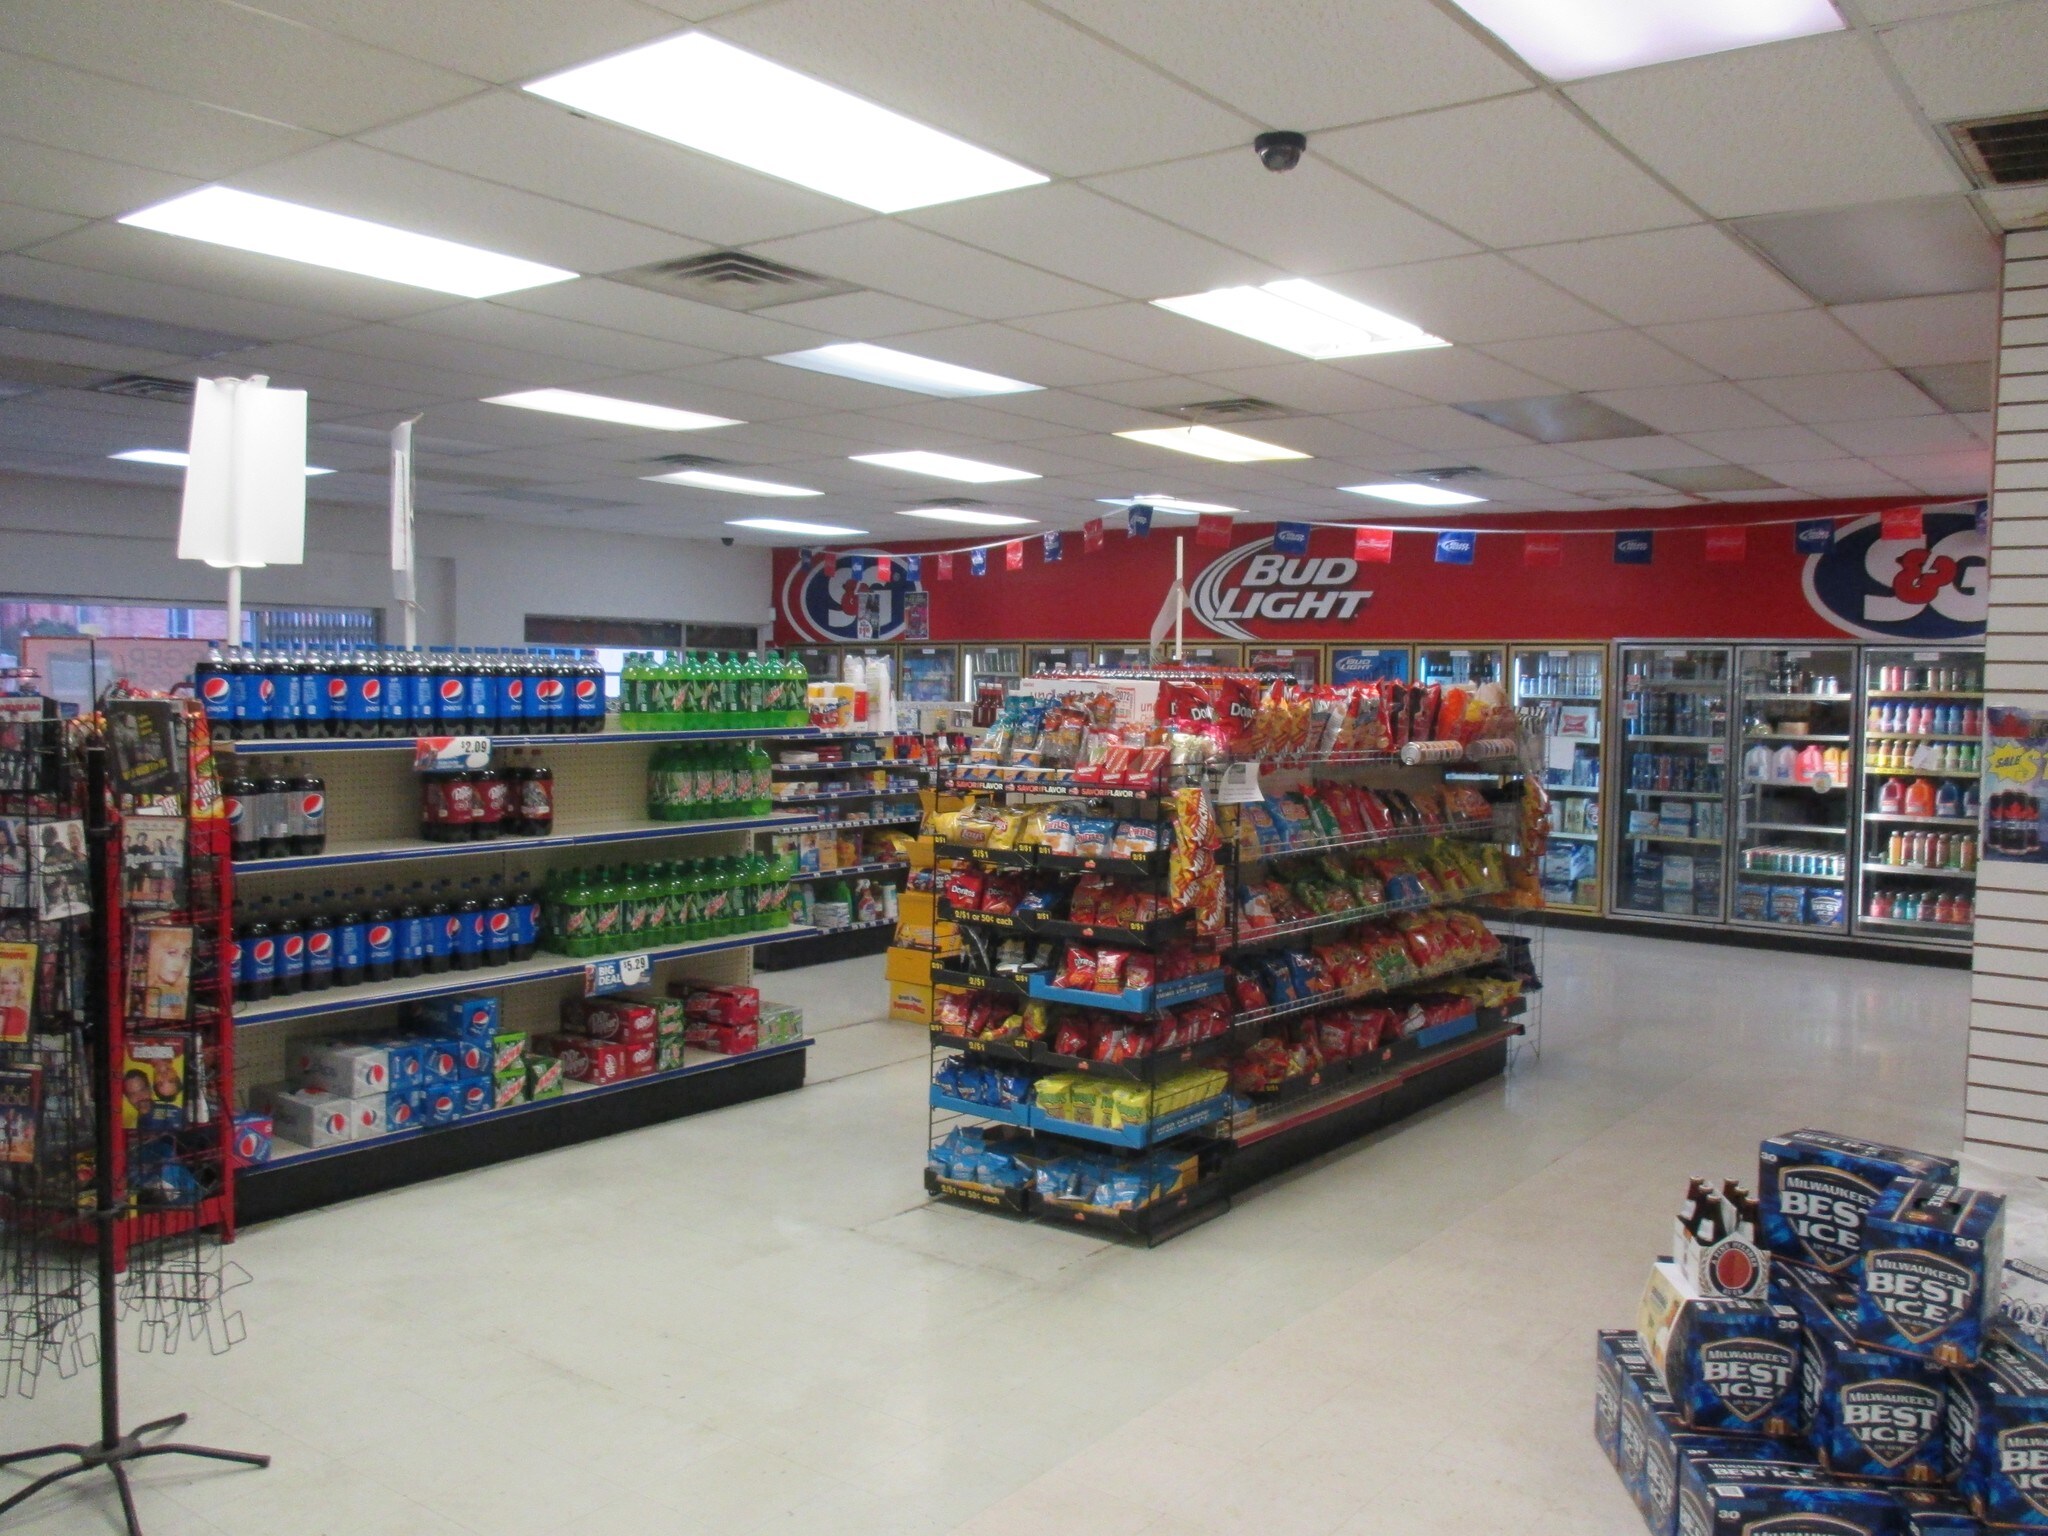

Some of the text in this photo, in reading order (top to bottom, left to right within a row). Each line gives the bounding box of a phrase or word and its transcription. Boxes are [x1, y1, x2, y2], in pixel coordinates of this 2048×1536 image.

[1241, 554, 1359, 587] BUD
[1214, 588, 1373, 620] LIGHT
[461, 741, 487, 753] $2.09
[1996, 755, 2022, 768] SALE
[972, 849, 989, 858] 2/$1
[951, 885, 976, 898] Doritos
[955, 910, 970, 919] 2/$1
[996, 916, 1013, 926] each
[598, 965, 615, 977] BIG
[624, 957, 646, 971] $5.29
[598, 974, 622, 986] DEAL
[969, 976, 985, 987] 2/$1
[968, 1042, 985, 1051] 2/$1
[1760, 1151, 1777, 1163] 30
[1780, 1190, 1870, 1230] BES
[1798, 1220, 1860, 1250] ICE
[1955, 1237, 1979, 1250] 30
[1875, 1258, 1967, 1288] MILWAUKEE'S
[1866, 1271, 1971, 1310] BEST
[1881, 1297, 1950, 1323] ICE
[1778, 1320, 1799, 1330] 30
[1708, 1350, 1790, 1363] MILWAUKEE'S
[1703, 1361, 1794, 1387] BEST
[1717, 1383, 1775, 1398] ICE
[1850, 1392, 1935, 1407] MILWAUKEE'S
[1843, 1404, 1938, 1430] BEST
[1859, 1426, 1918, 1444] ICE
[2001, 1450, 2048, 1471] BE
[1712, 1468, 1816, 1480] BEST ICE
[2019, 1473, 2048, 1489] IC
[1718, 1509, 1741, 1520] 30
